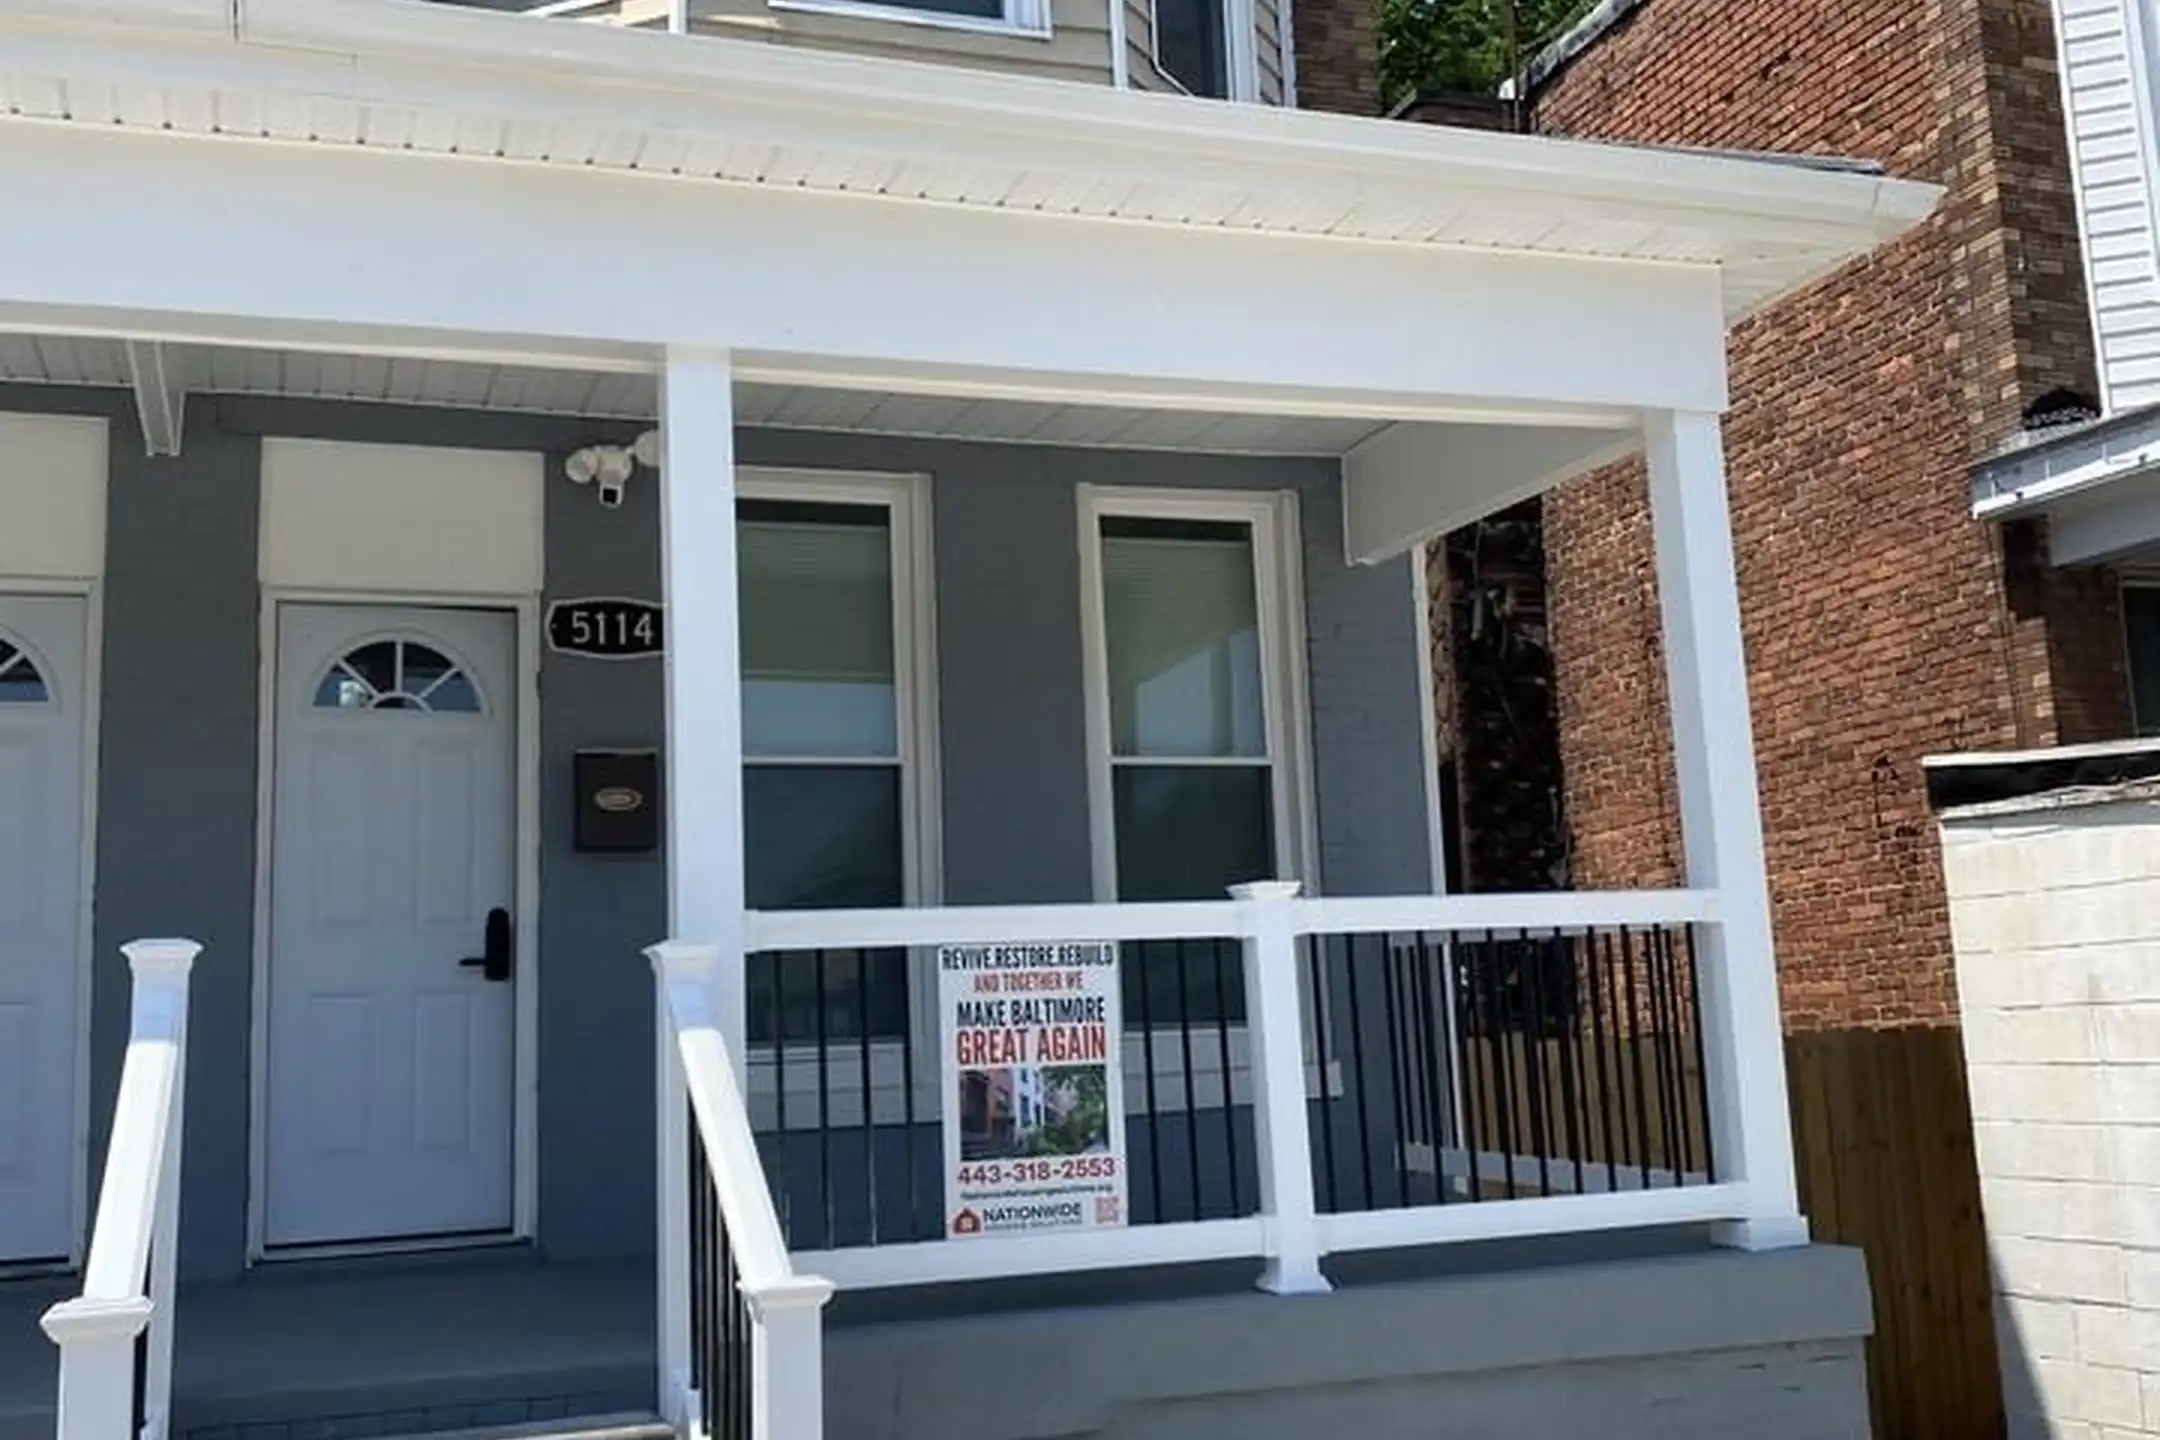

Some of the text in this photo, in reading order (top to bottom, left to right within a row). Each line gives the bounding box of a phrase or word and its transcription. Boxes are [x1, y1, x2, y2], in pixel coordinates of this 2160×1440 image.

[571, 609, 655, 645] 5114
[973, 970, 1083, 994] AND TOGETHER WE
[957, 996, 1105, 1027] MAKE BALTIMORE
[957, 1024, 1105, 1064] GREAT AGAIN
[958, 1156, 1116, 1185] 443-318-2553
[983, 1202, 1082, 1222] NATIONWIDE
